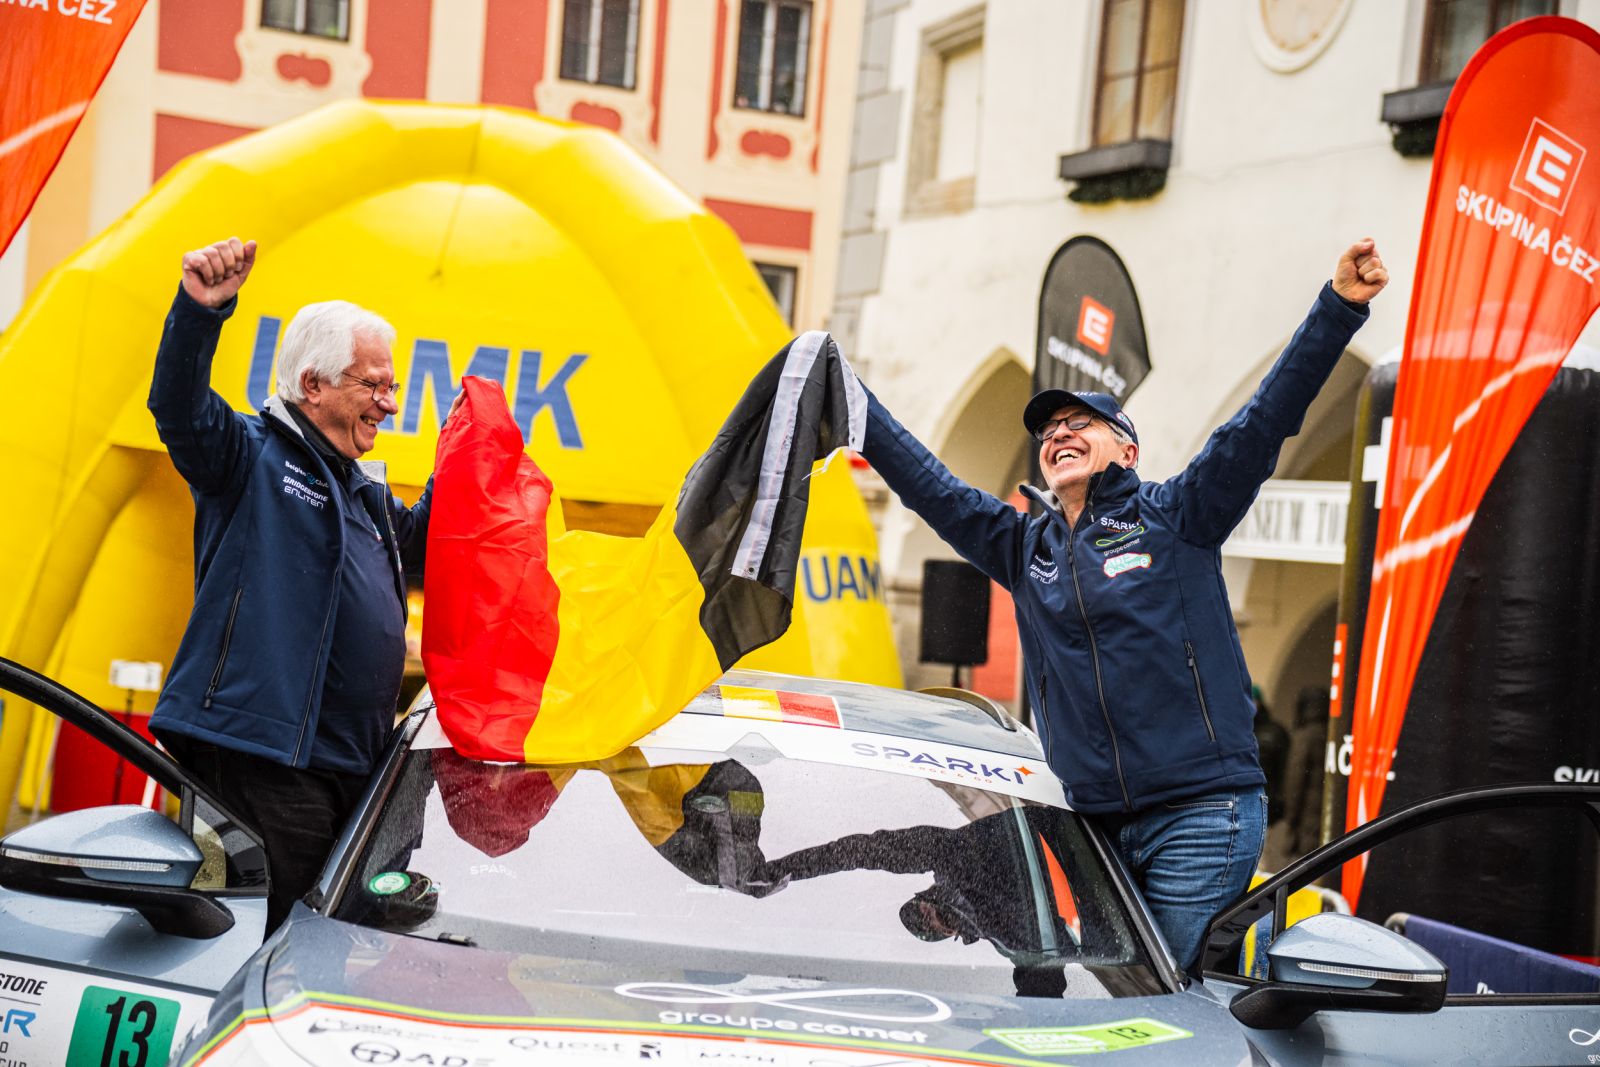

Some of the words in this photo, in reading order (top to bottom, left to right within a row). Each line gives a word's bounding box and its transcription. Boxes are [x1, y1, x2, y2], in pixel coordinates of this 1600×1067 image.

[1455, 185, 1551, 256] SKUPINA
[1551, 233, 1600, 284] ČEZ
[282, 475, 329, 502] BRIDGESTONE
[851, 742, 1034, 785] SPARKI
[100, 995, 158, 1067] 13
[508, 1035, 625, 1055] Quest
[658, 1009, 797, 1032] groupe
[802, 1020, 929, 1045] comet
